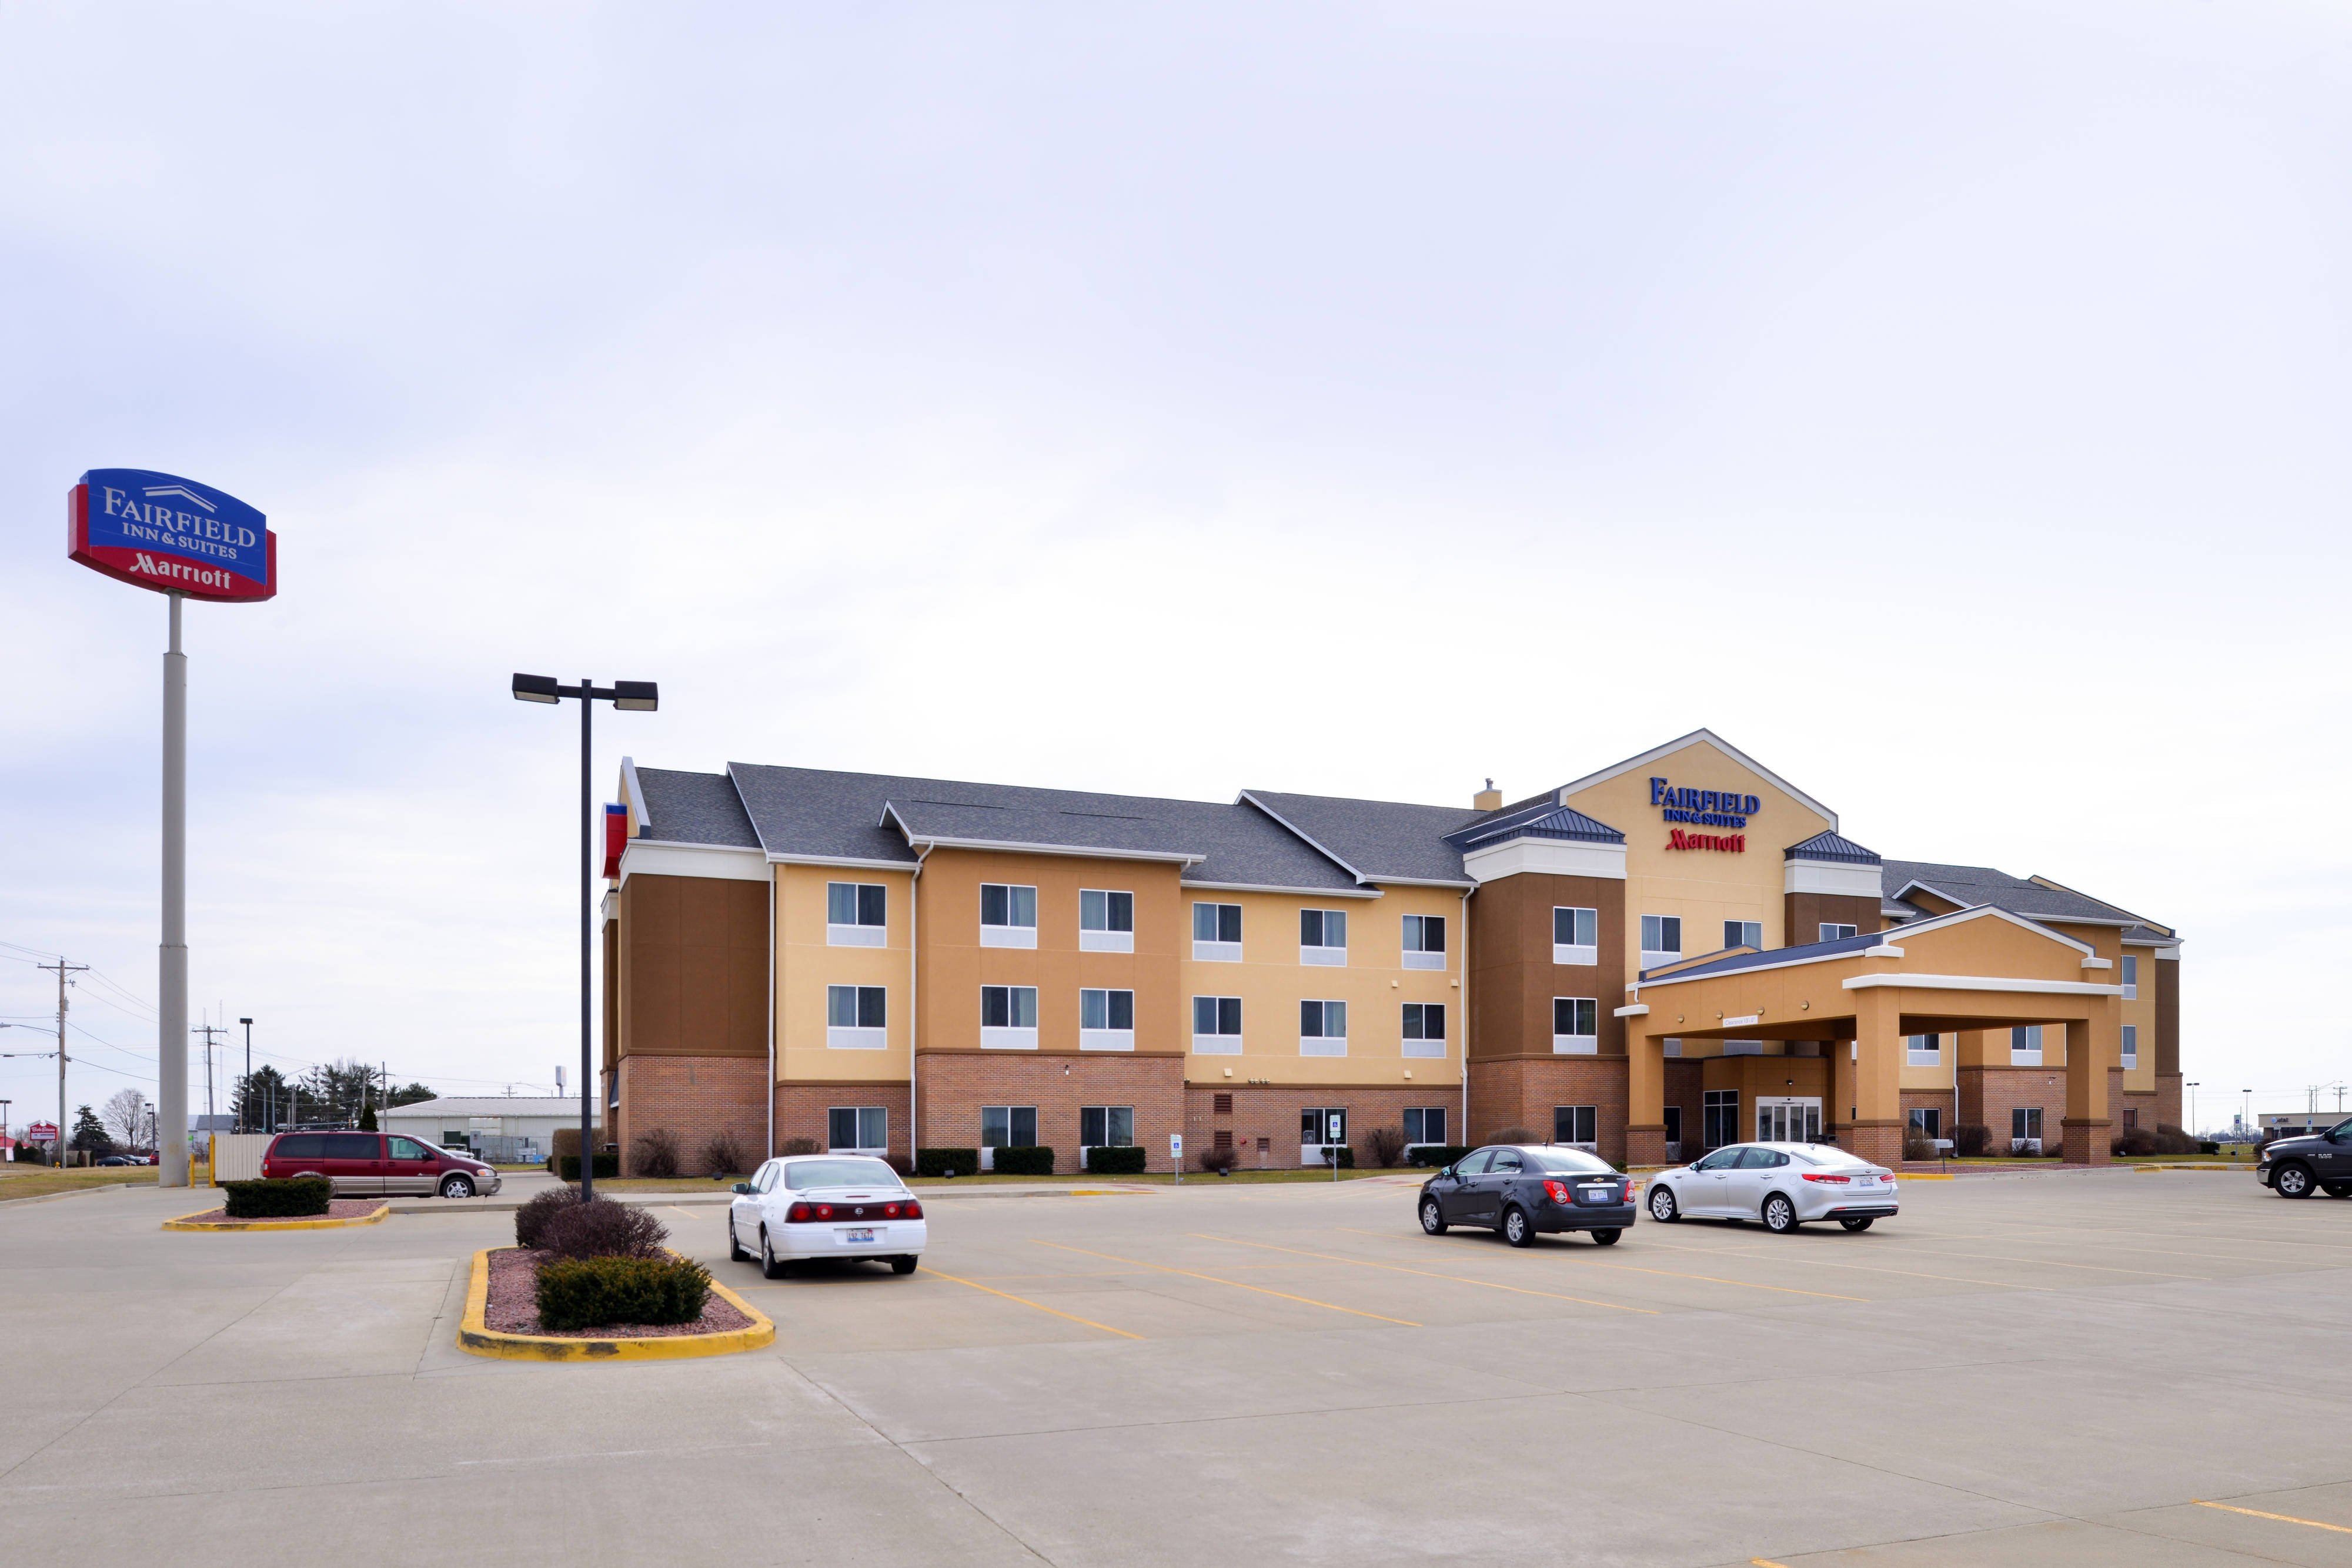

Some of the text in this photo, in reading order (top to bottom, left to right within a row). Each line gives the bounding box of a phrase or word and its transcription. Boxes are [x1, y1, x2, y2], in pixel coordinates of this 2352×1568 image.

[103, 486, 256, 547] FAIRFIELD
[122, 522, 238, 560] INN & SUITES
[129, 552, 231, 589] Marriott
[1649, 777, 1760, 814] FAIRFIELD
[1663, 808, 1747, 828] INN & SUITES
[1665, 828, 1746, 852] Marriott
